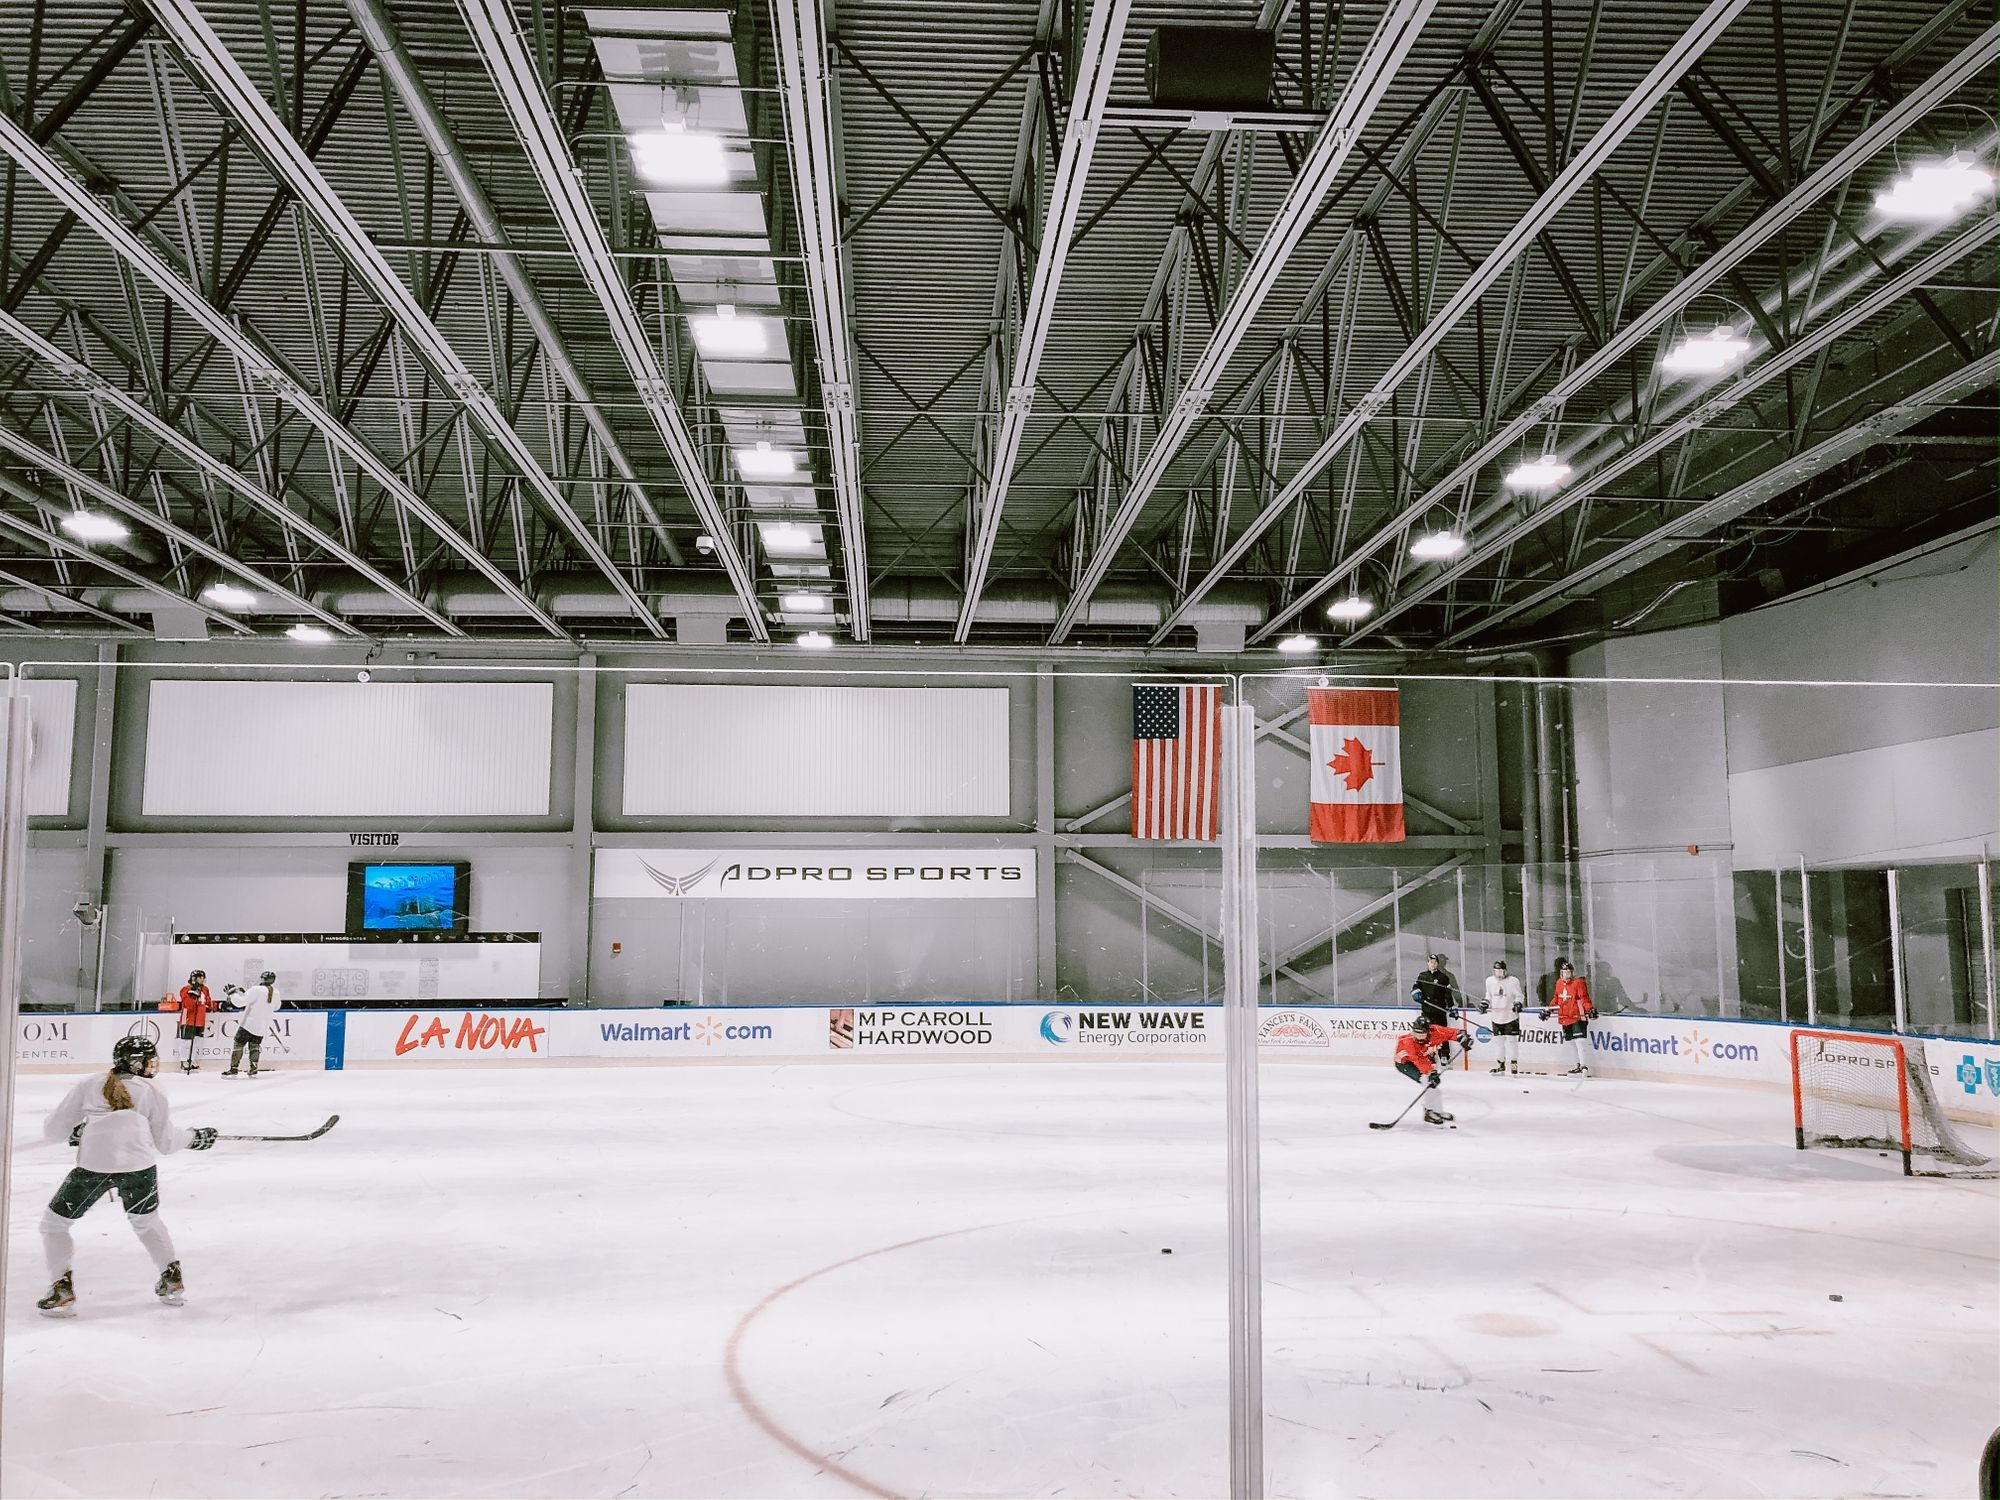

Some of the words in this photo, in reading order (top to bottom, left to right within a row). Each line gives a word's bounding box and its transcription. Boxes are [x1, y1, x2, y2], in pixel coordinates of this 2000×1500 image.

[349, 833, 400, 846] VISITOR
[720, 864, 852, 892] ADPRO
[866, 866, 1022, 881] SPORTS
[901, 1011, 993, 1026] CAROLL
[1079, 1012, 1131, 1029] NEW
[1139, 1012, 1205, 1029] WAVE
[1258, 1013, 1296, 1039] YANCEY'S
[1298, 1015, 1326, 1040] FANCY
[1330, 1019, 1388, 1031] YANCEY'S
[1392, 1021, 1414, 1031] FAN
[395, 1014, 451, 1056] LA
[455, 1012, 545, 1052] NOVA
[600, 1022, 691, 1042] Walmart
[725, 1024, 772, 1040] com
[858, 1030, 993, 1045] HARDWOOD
[1079, 1030, 1124, 1047] Energy
[1127, 1030, 1207, 1046] Corporation
[1518, 1029, 1565, 1044] HOCKEY
[1590, 1030, 1679, 1056] Walmart
[1712, 1042, 1759, 1062] com
